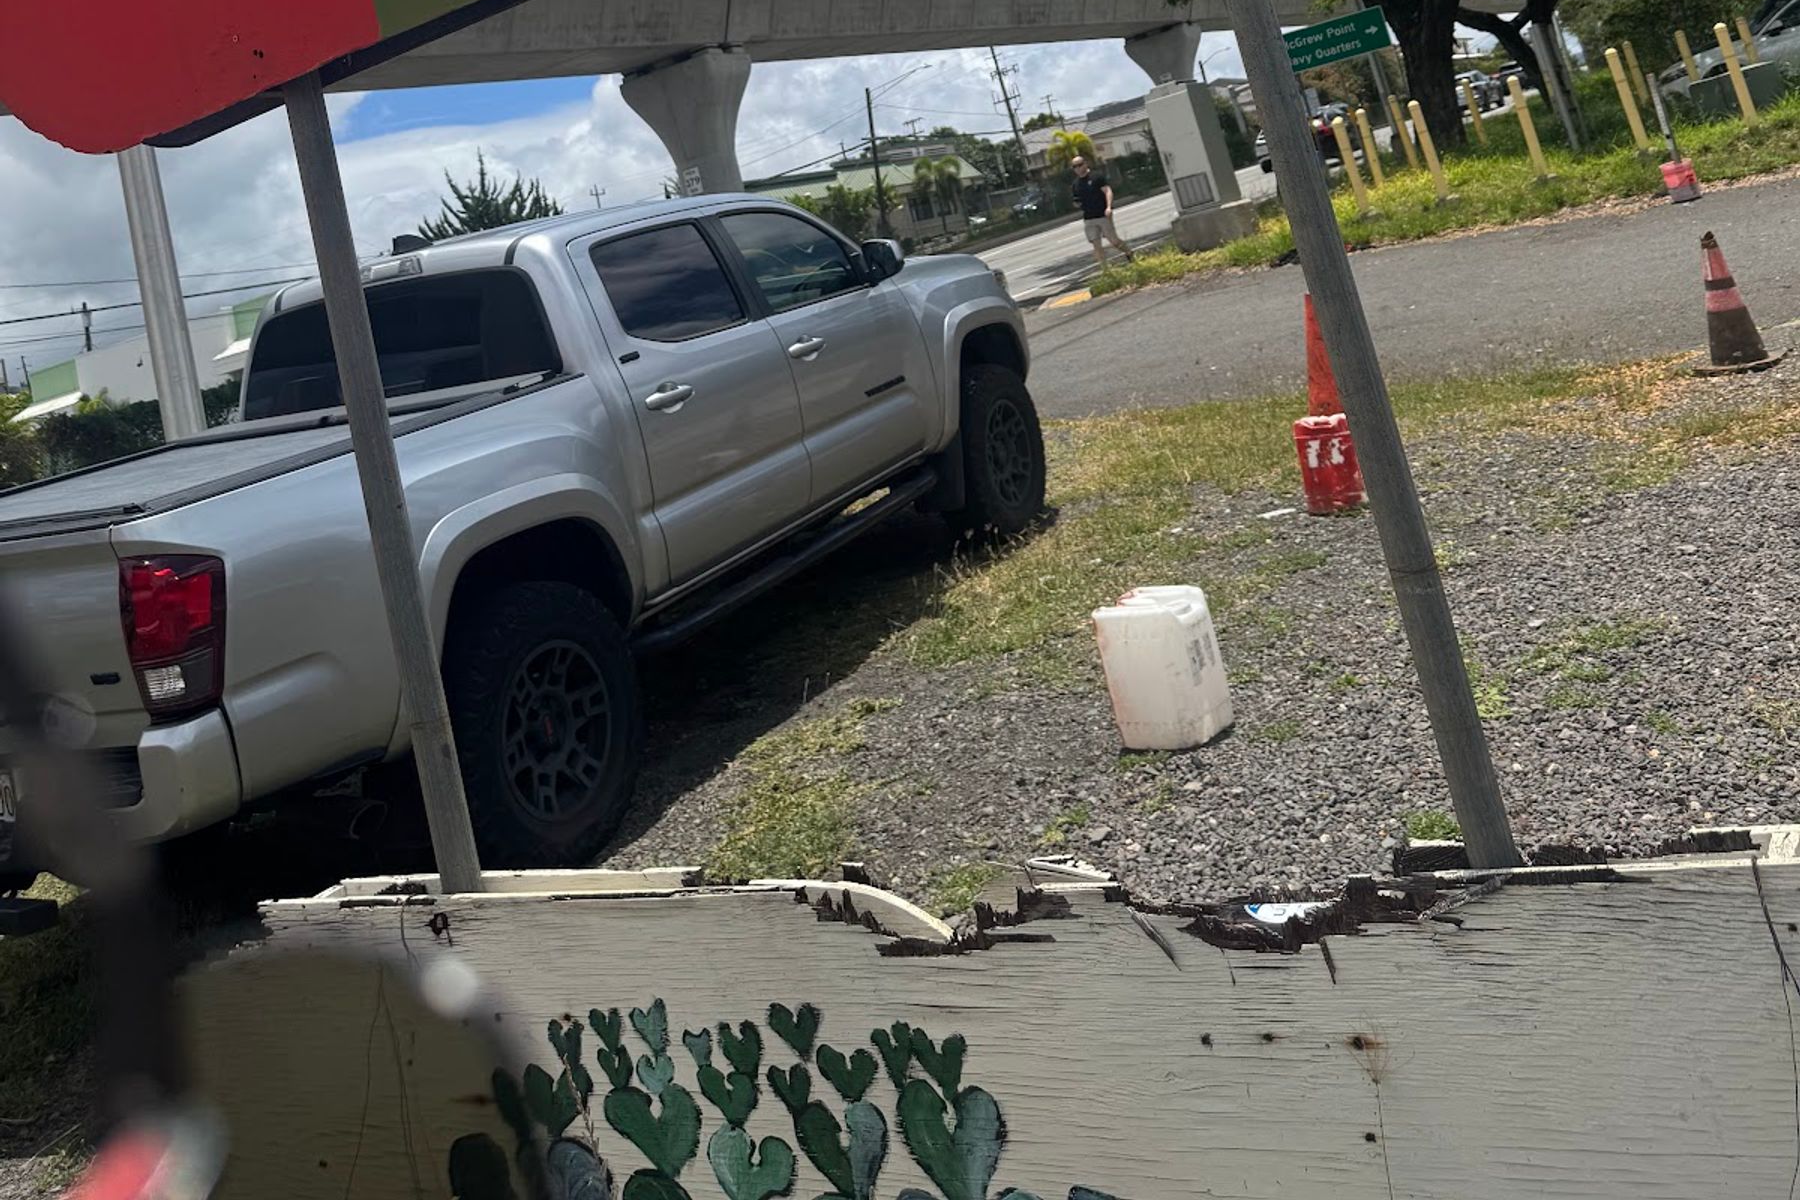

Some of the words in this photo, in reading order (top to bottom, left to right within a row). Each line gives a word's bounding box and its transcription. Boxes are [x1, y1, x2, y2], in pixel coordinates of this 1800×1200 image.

[1326, 22, 1356, 39] Point
[1291, 52, 1313, 65] avy
[1315, 38, 1362, 60] Quarters
